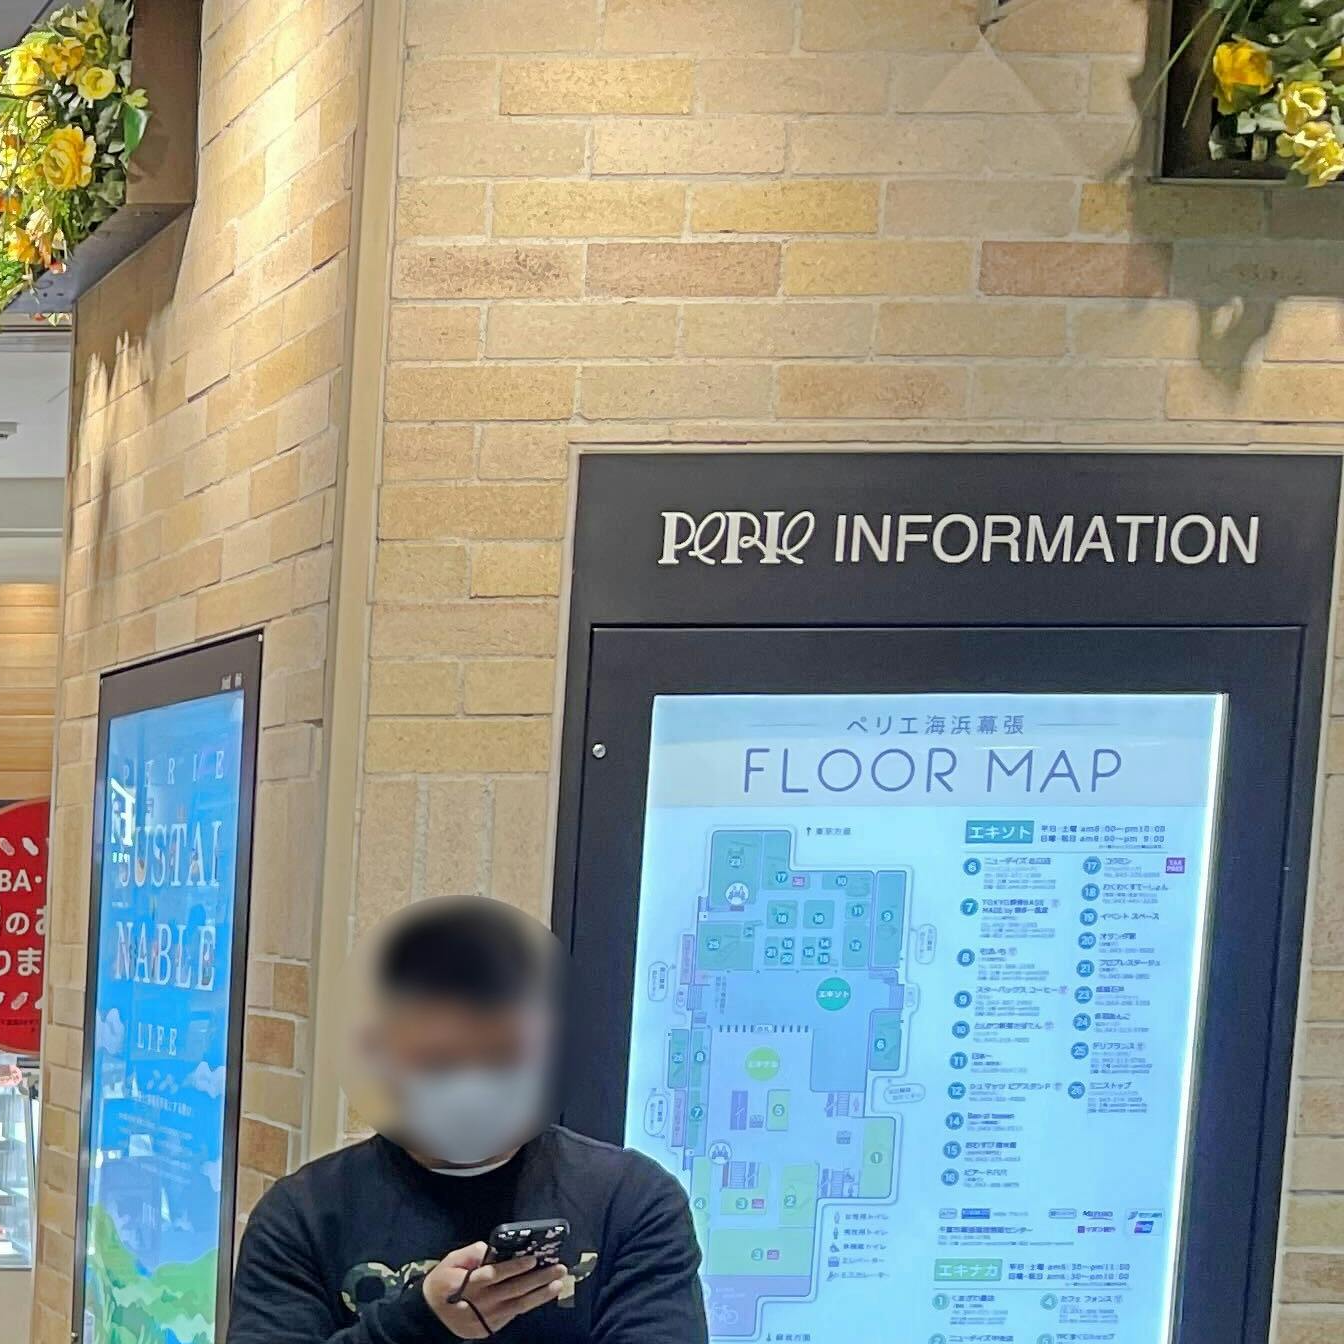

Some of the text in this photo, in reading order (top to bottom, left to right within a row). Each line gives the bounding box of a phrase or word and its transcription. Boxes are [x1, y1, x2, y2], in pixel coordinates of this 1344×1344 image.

[834, 513, 1259, 565] INFORMATION
[846, 714, 1025, 736] ペリエ海浜幕張
[743, 747, 1123, 794] FLOOR MAP
[968, 825, 1033, 841] エキソト
[115, 919, 217, 993] NABLE
[136, 1020, 178, 1056] LIFE
[938, 1263, 1000, 1278] エキナカ
